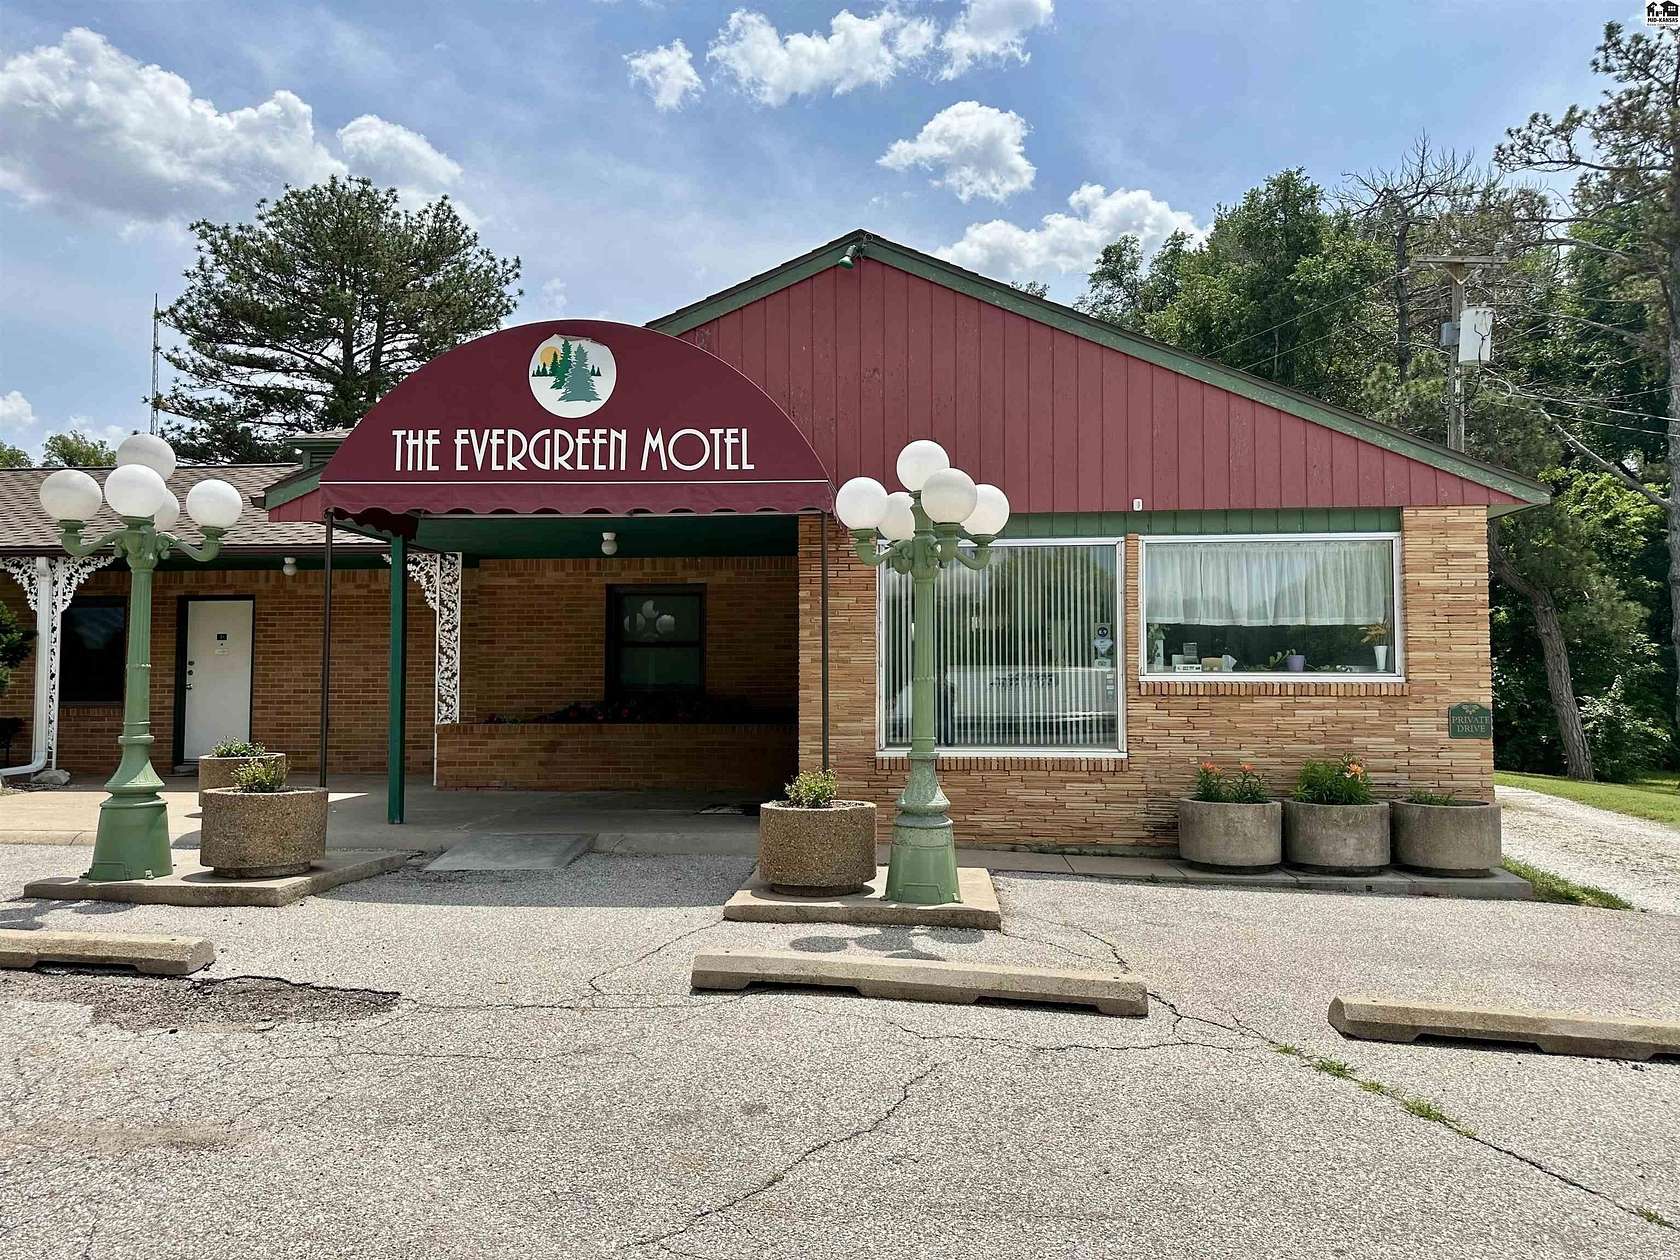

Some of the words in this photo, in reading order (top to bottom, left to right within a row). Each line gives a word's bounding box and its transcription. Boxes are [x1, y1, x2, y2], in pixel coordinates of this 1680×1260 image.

[392, 429, 440, 471] THE
[453, 428, 627, 471] EVERGREEN
[640, 427, 755, 471] MOTEL
[1451, 716, 1489, 724] PRIVATE
[1457, 725, 1486, 733] DRIVE
